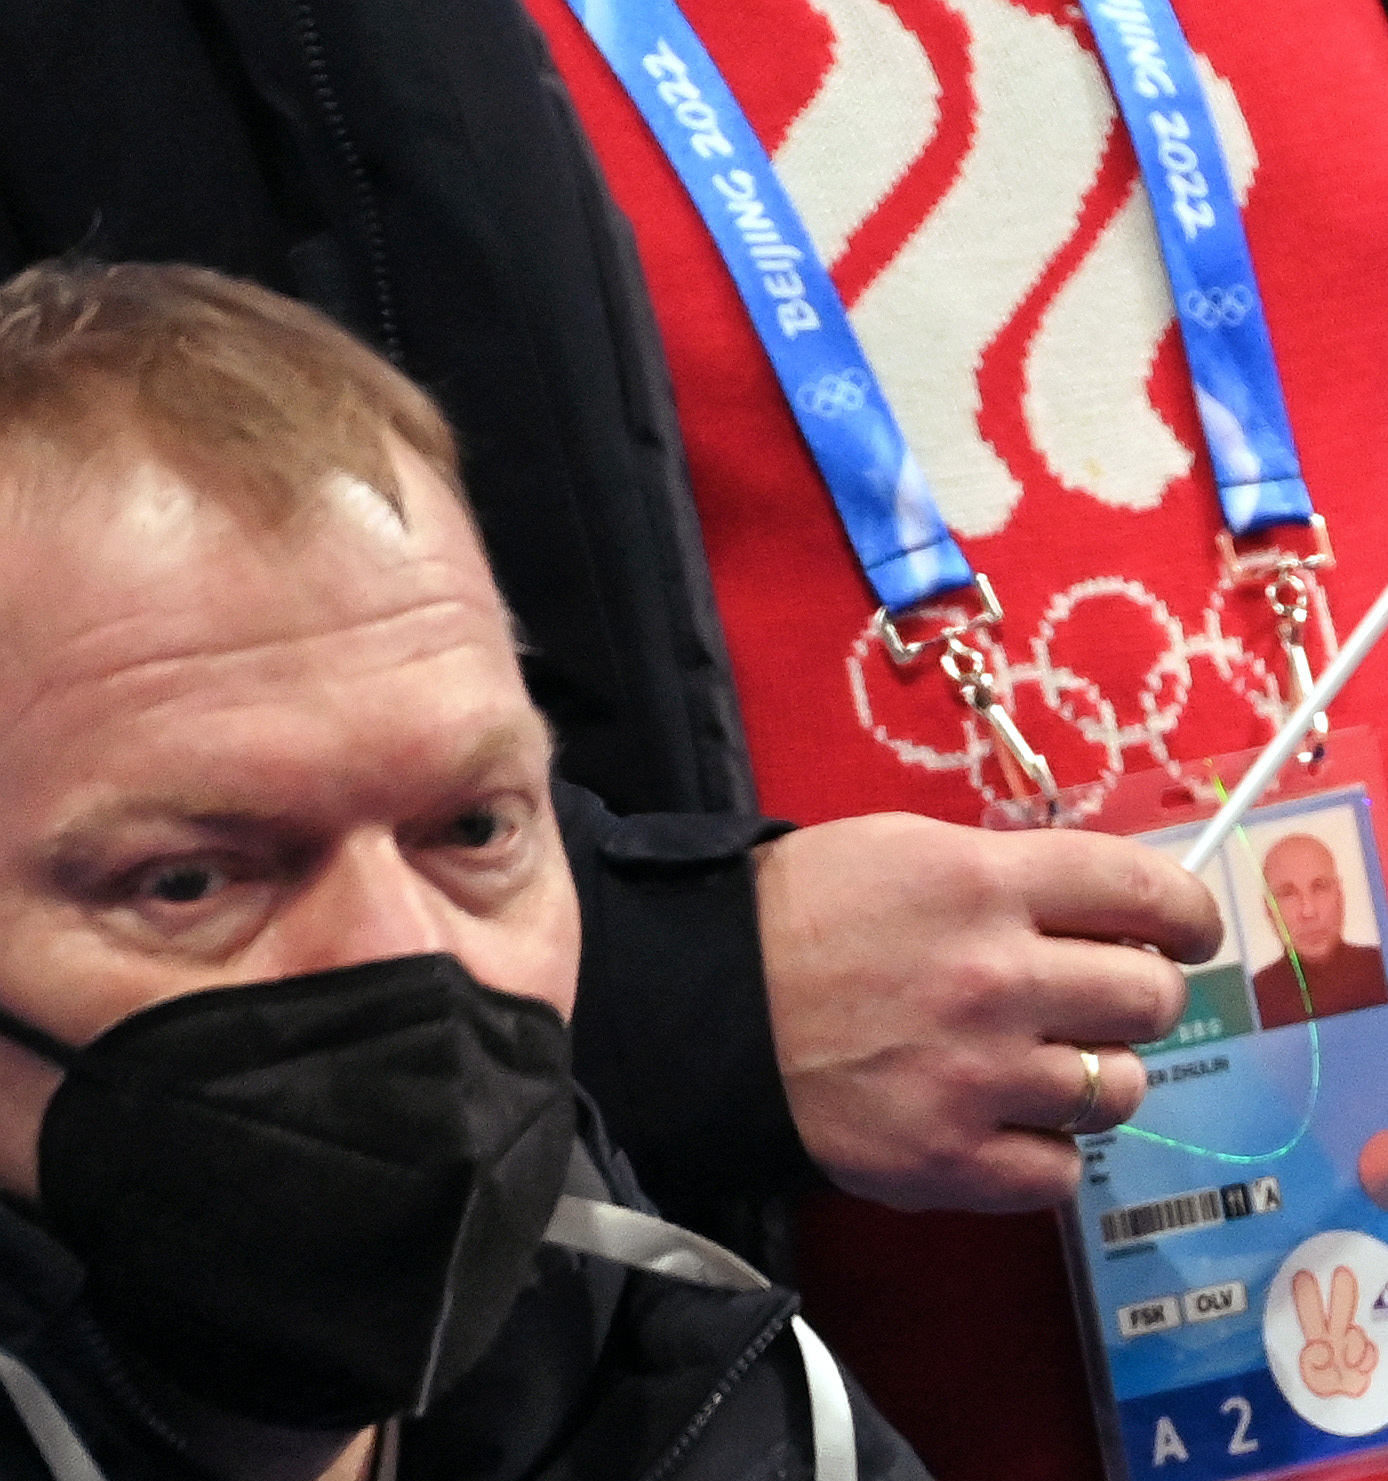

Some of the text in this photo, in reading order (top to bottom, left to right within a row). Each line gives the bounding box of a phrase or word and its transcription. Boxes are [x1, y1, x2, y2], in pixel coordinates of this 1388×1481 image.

[642, 36, 821, 340] BEIJING 2022
[1150, 110, 1216, 243] 2022
[1130, 1290, 1233, 1328] FSK OLV
[1152, 1416, 1189, 1467] A
[1221, 1396, 1259, 1456] 2
